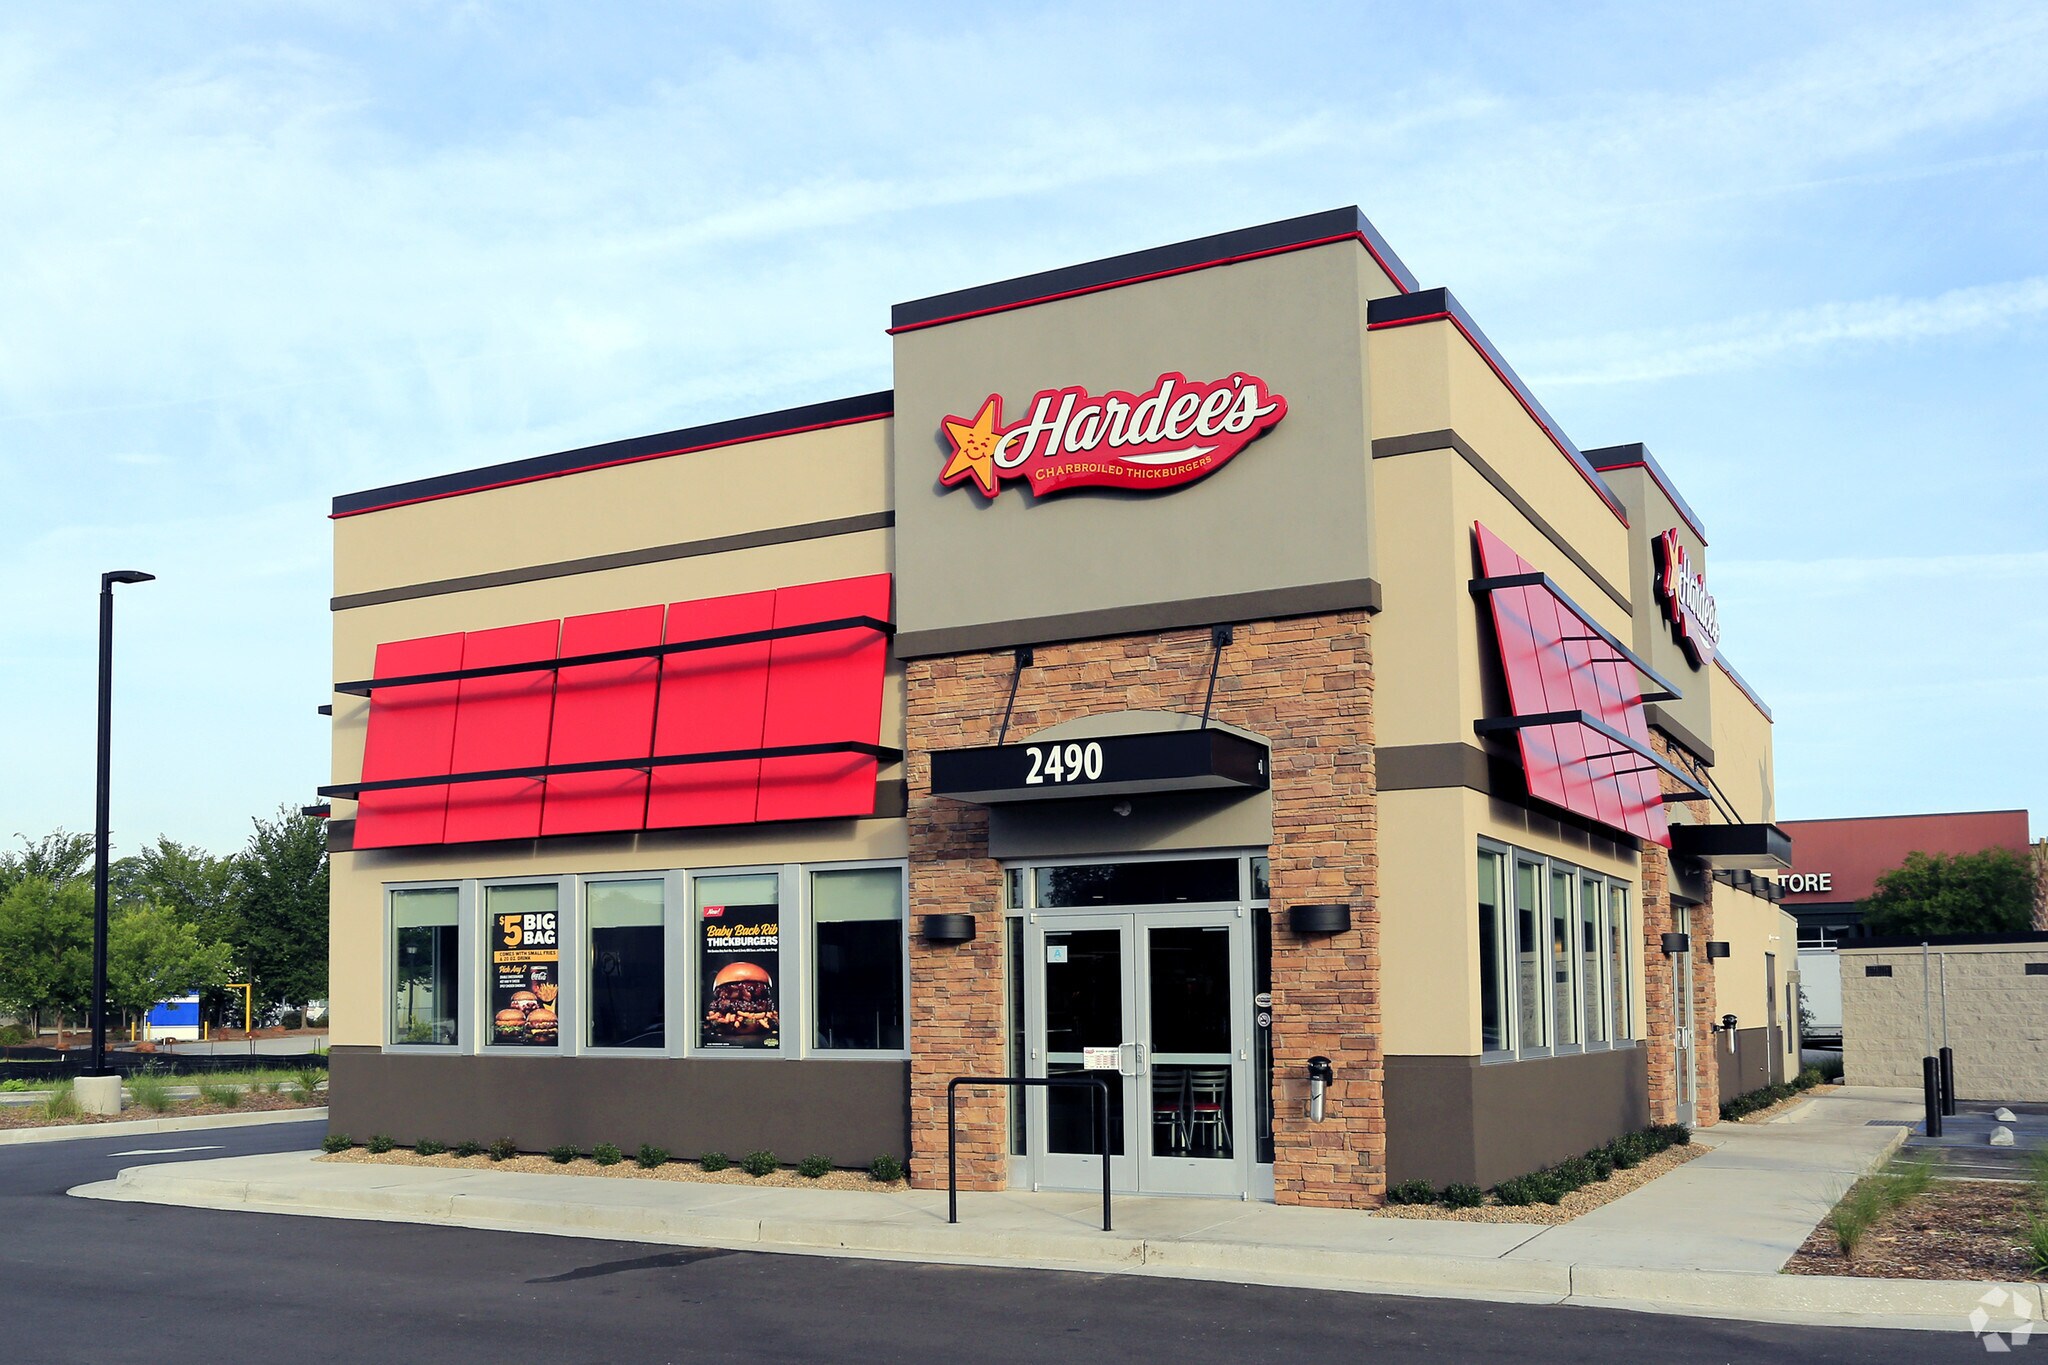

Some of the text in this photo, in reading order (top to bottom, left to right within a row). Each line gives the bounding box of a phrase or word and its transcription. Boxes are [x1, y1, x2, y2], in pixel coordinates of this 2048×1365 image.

[994, 376, 1278, 468] Hardee's
[1035, 455, 1212, 481] CHARBROILED THICKBURGERS
[1025, 742, 1103, 785] 2490
[499, 914, 522, 946] $5
[523, 913, 556, 930] BIG
[523, 930, 556, 944] BAG
[707, 923, 778, 939] Baby Back Rib
[706, 936, 778, 947] THICKBURGERS
[499, 964, 527, 974] Pick Any 2
